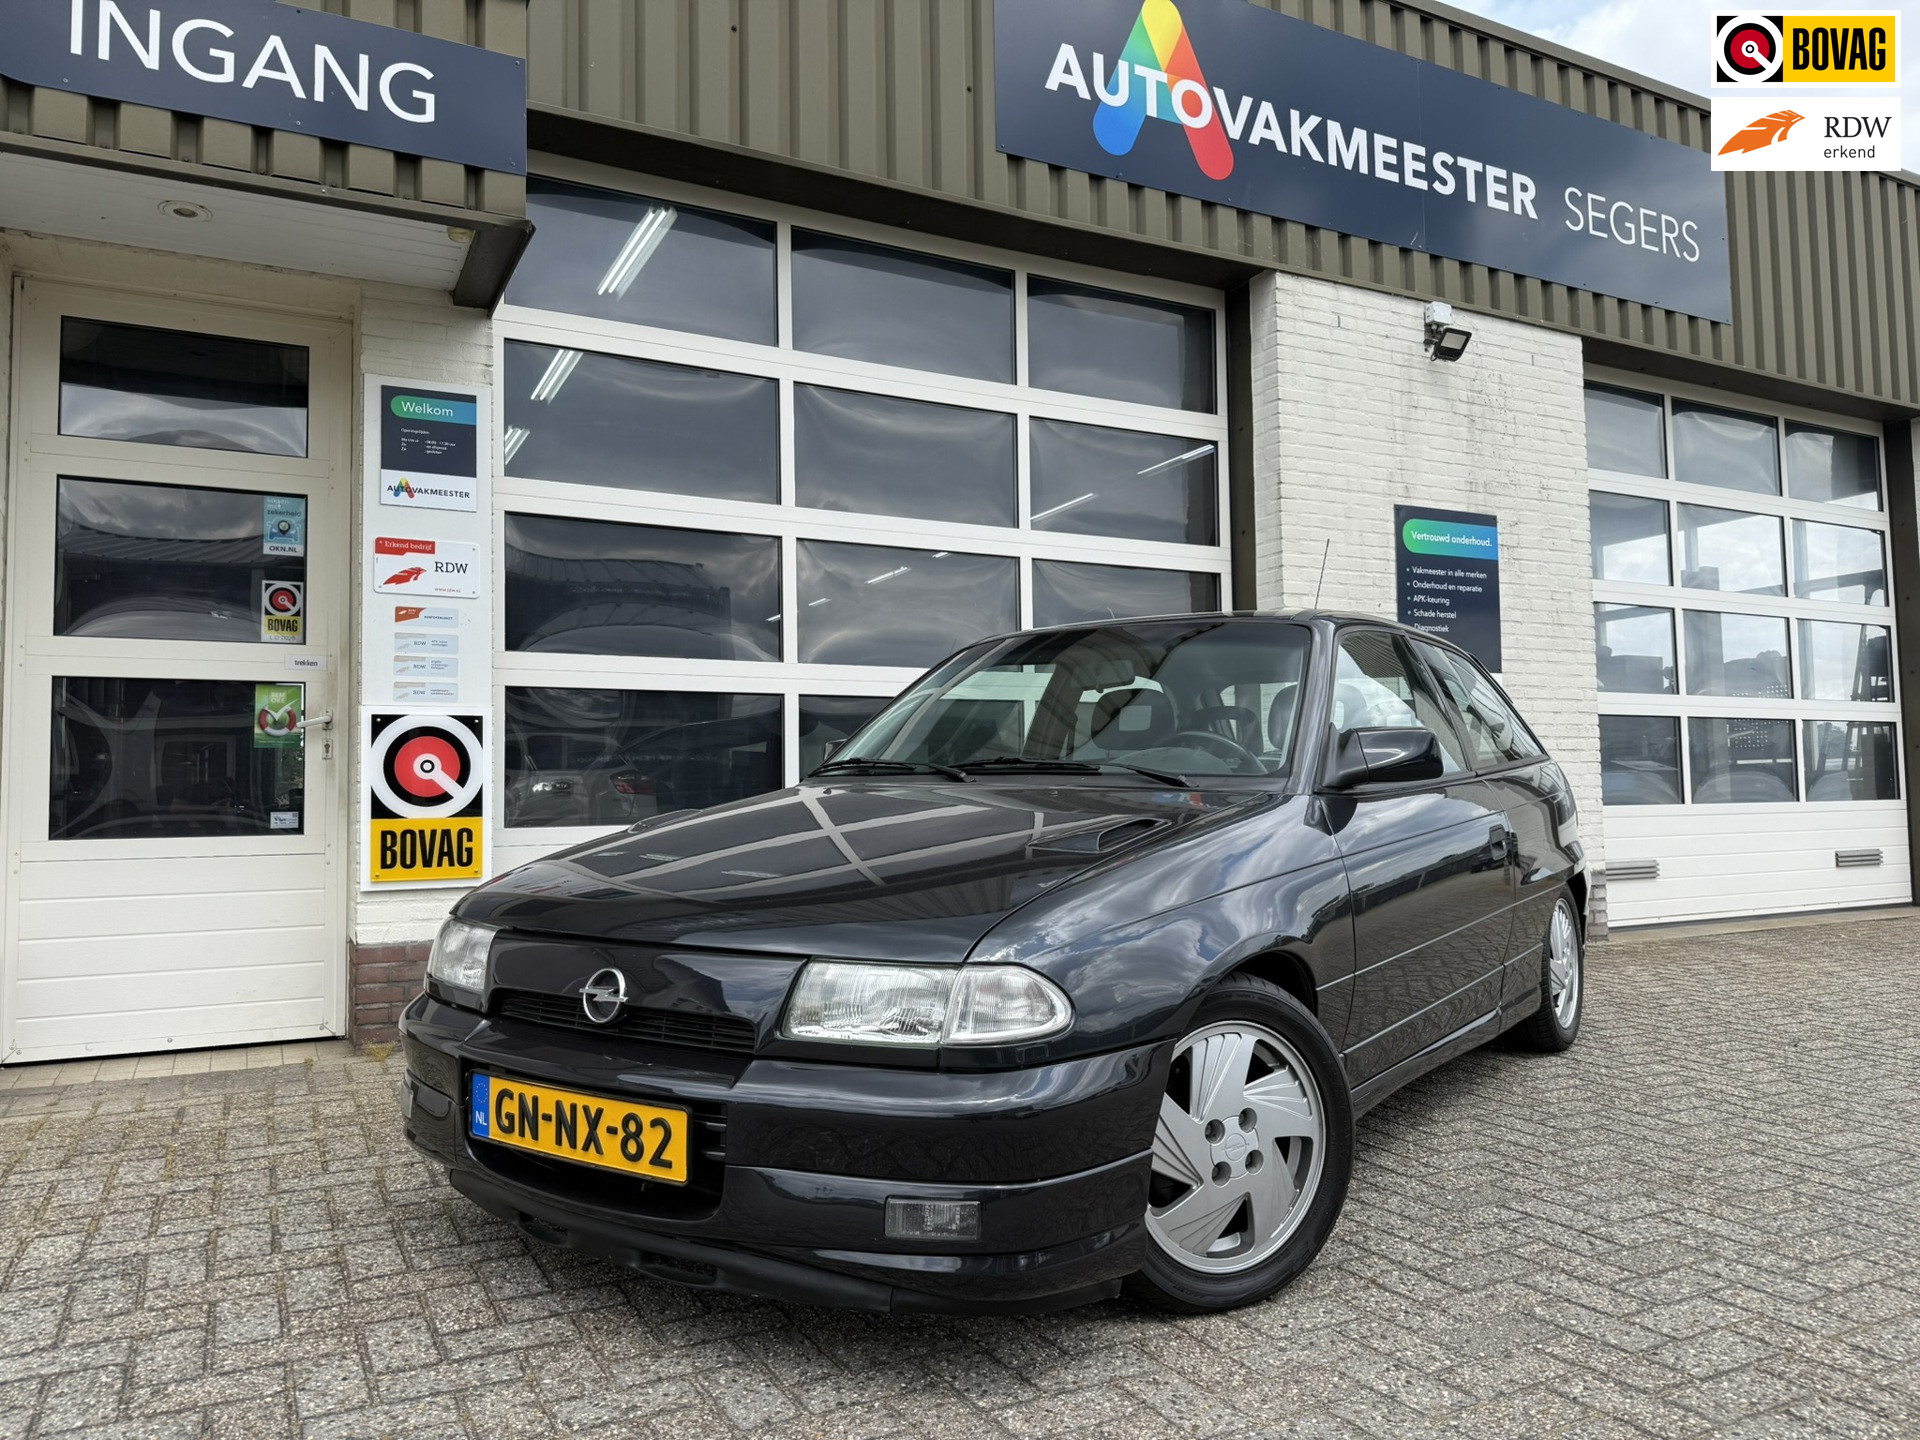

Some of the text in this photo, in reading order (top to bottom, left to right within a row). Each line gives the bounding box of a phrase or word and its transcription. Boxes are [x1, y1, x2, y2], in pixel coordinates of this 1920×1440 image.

[69, 0, 436, 123] INGANG
[1045, 43, 1700, 263] AUTOVAKMEESTER SEGERS
[401, 401, 453, 416] Welkom
[387, 485, 470, 498] AUTOVAKMEESTER
[1411, 531, 1492, 547] Vertrouwd onderhoud.
[269, 545, 298, 553] OKN.NL
[384, 541, 432, 551] Erkend bedrijf
[434, 561, 468, 574] RDW
[1412, 566, 1487, 579] Vakmeester in alle merken
[1412, 580, 1448, 591] Onderhoud
[1456, 584, 1483, 593] reparatie
[1413, 595, 1450, 606] APK-keuring
[1413, 609, 1457, 619] Schade herstel
[268, 618, 298, 632] BOVAG
[294, 659, 318, 667] trekken
[380, 827, 473, 870] BOVAG
[475, 1088, 673, 1169] NL GN-NX-82
